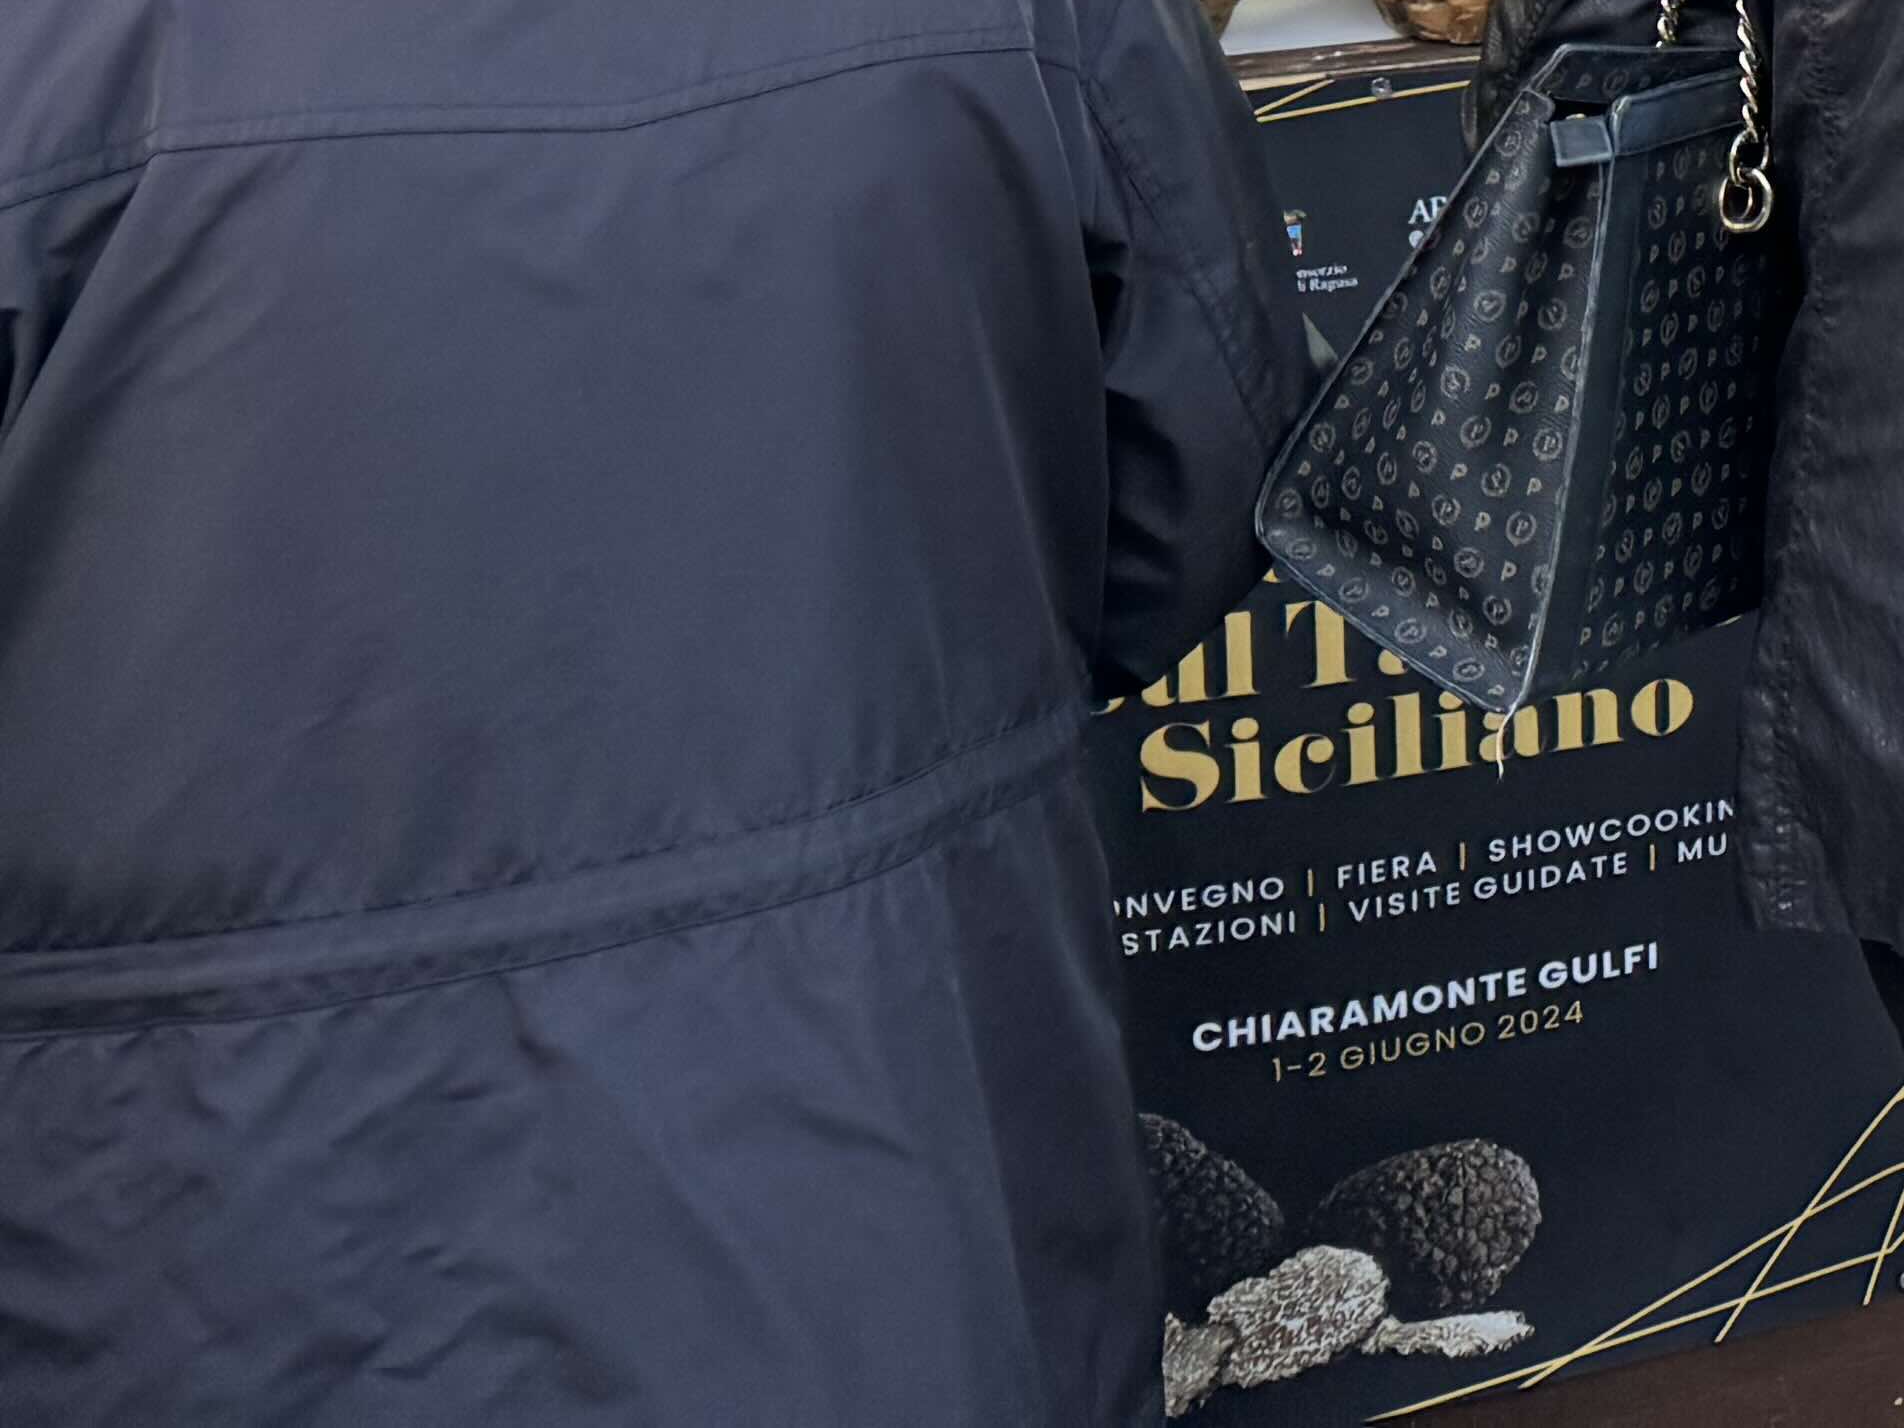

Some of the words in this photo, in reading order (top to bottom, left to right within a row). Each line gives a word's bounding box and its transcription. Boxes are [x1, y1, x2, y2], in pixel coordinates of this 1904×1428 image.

[1139, 677, 1695, 814] Siciliano
[1121, 910, 1297, 956] STAZIONI
[1348, 881, 1461, 923] VISITE
[1473, 851, 1628, 900] GUIDATE
[1337, 850, 1438, 889] FIERA
[1191, 965, 1528, 1053] CHIARAMONTE
[1538, 940, 1659, 991] GULFI
[1270, 1051, 1328, 1083] 1-2
[1339, 1020, 1486, 1071] GIUGNO
[1497, 998, 1586, 1040] 2024
